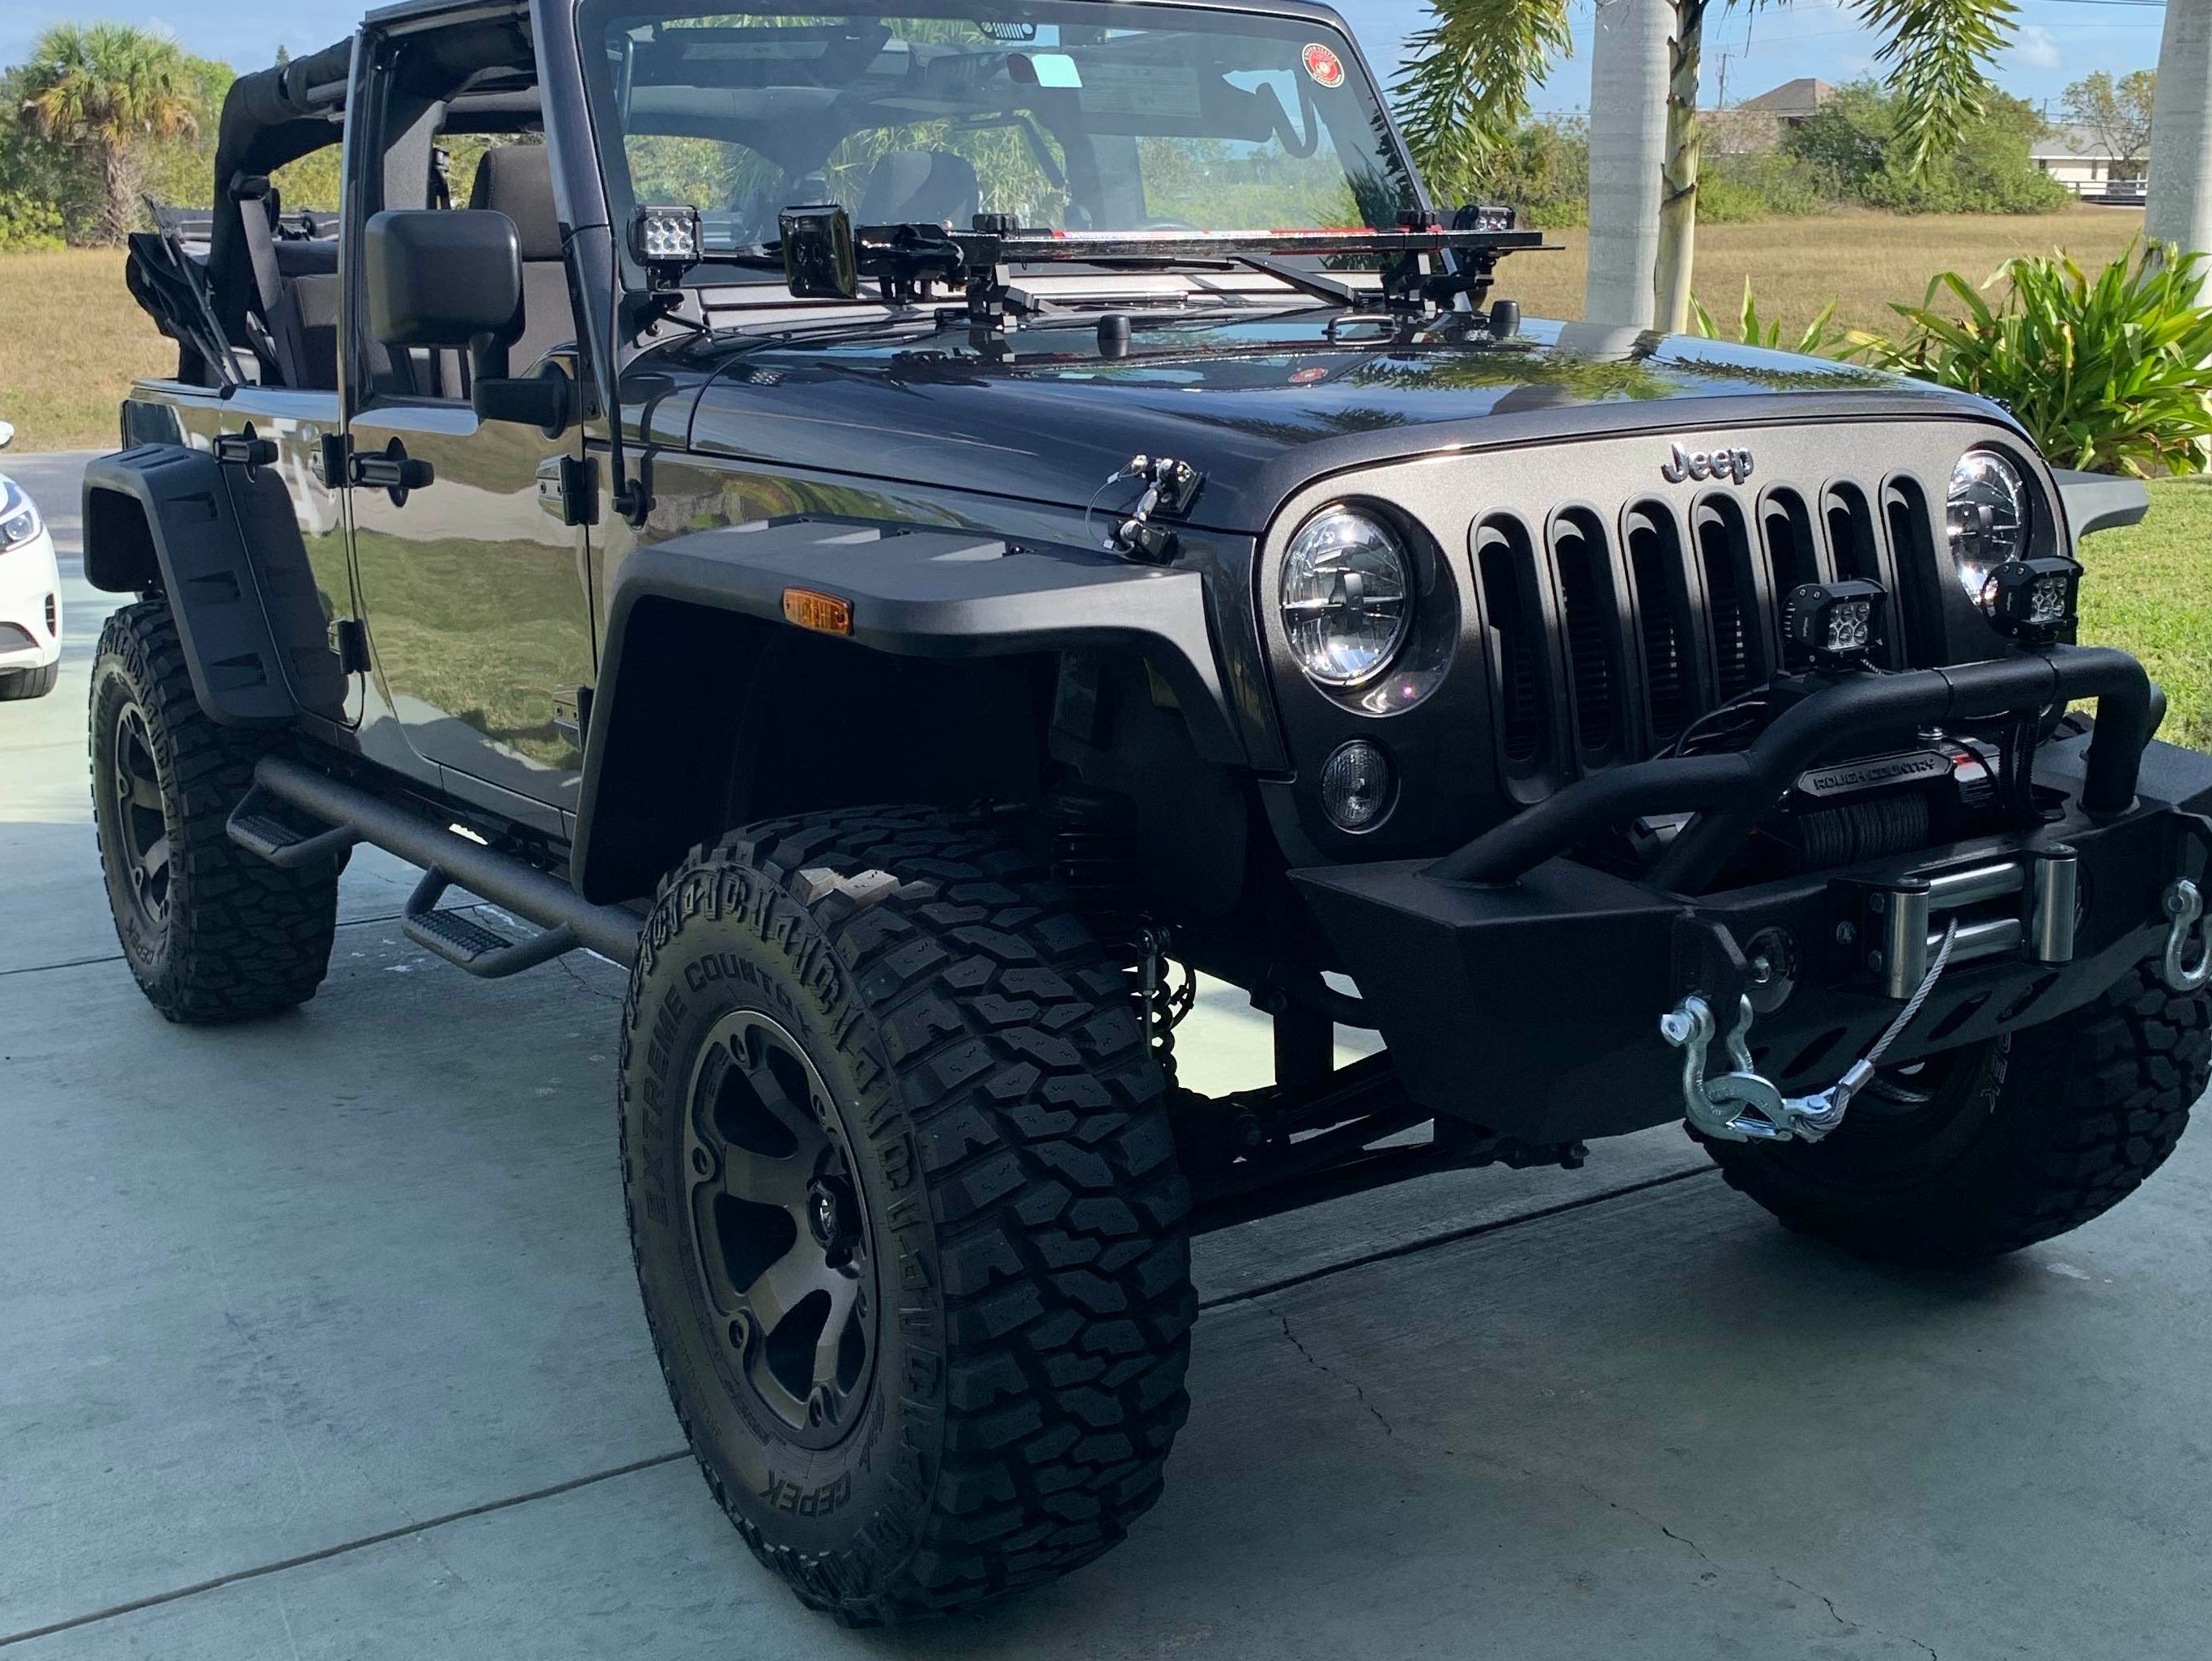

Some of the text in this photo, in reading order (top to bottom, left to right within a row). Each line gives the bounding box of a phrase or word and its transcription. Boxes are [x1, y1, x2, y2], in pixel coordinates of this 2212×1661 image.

[1661, 441, 1755, 486] Jeep
[1813, 758, 1936, 791] ROUGH COUNTRY
[759, 1468, 852, 1519] CEPEK
